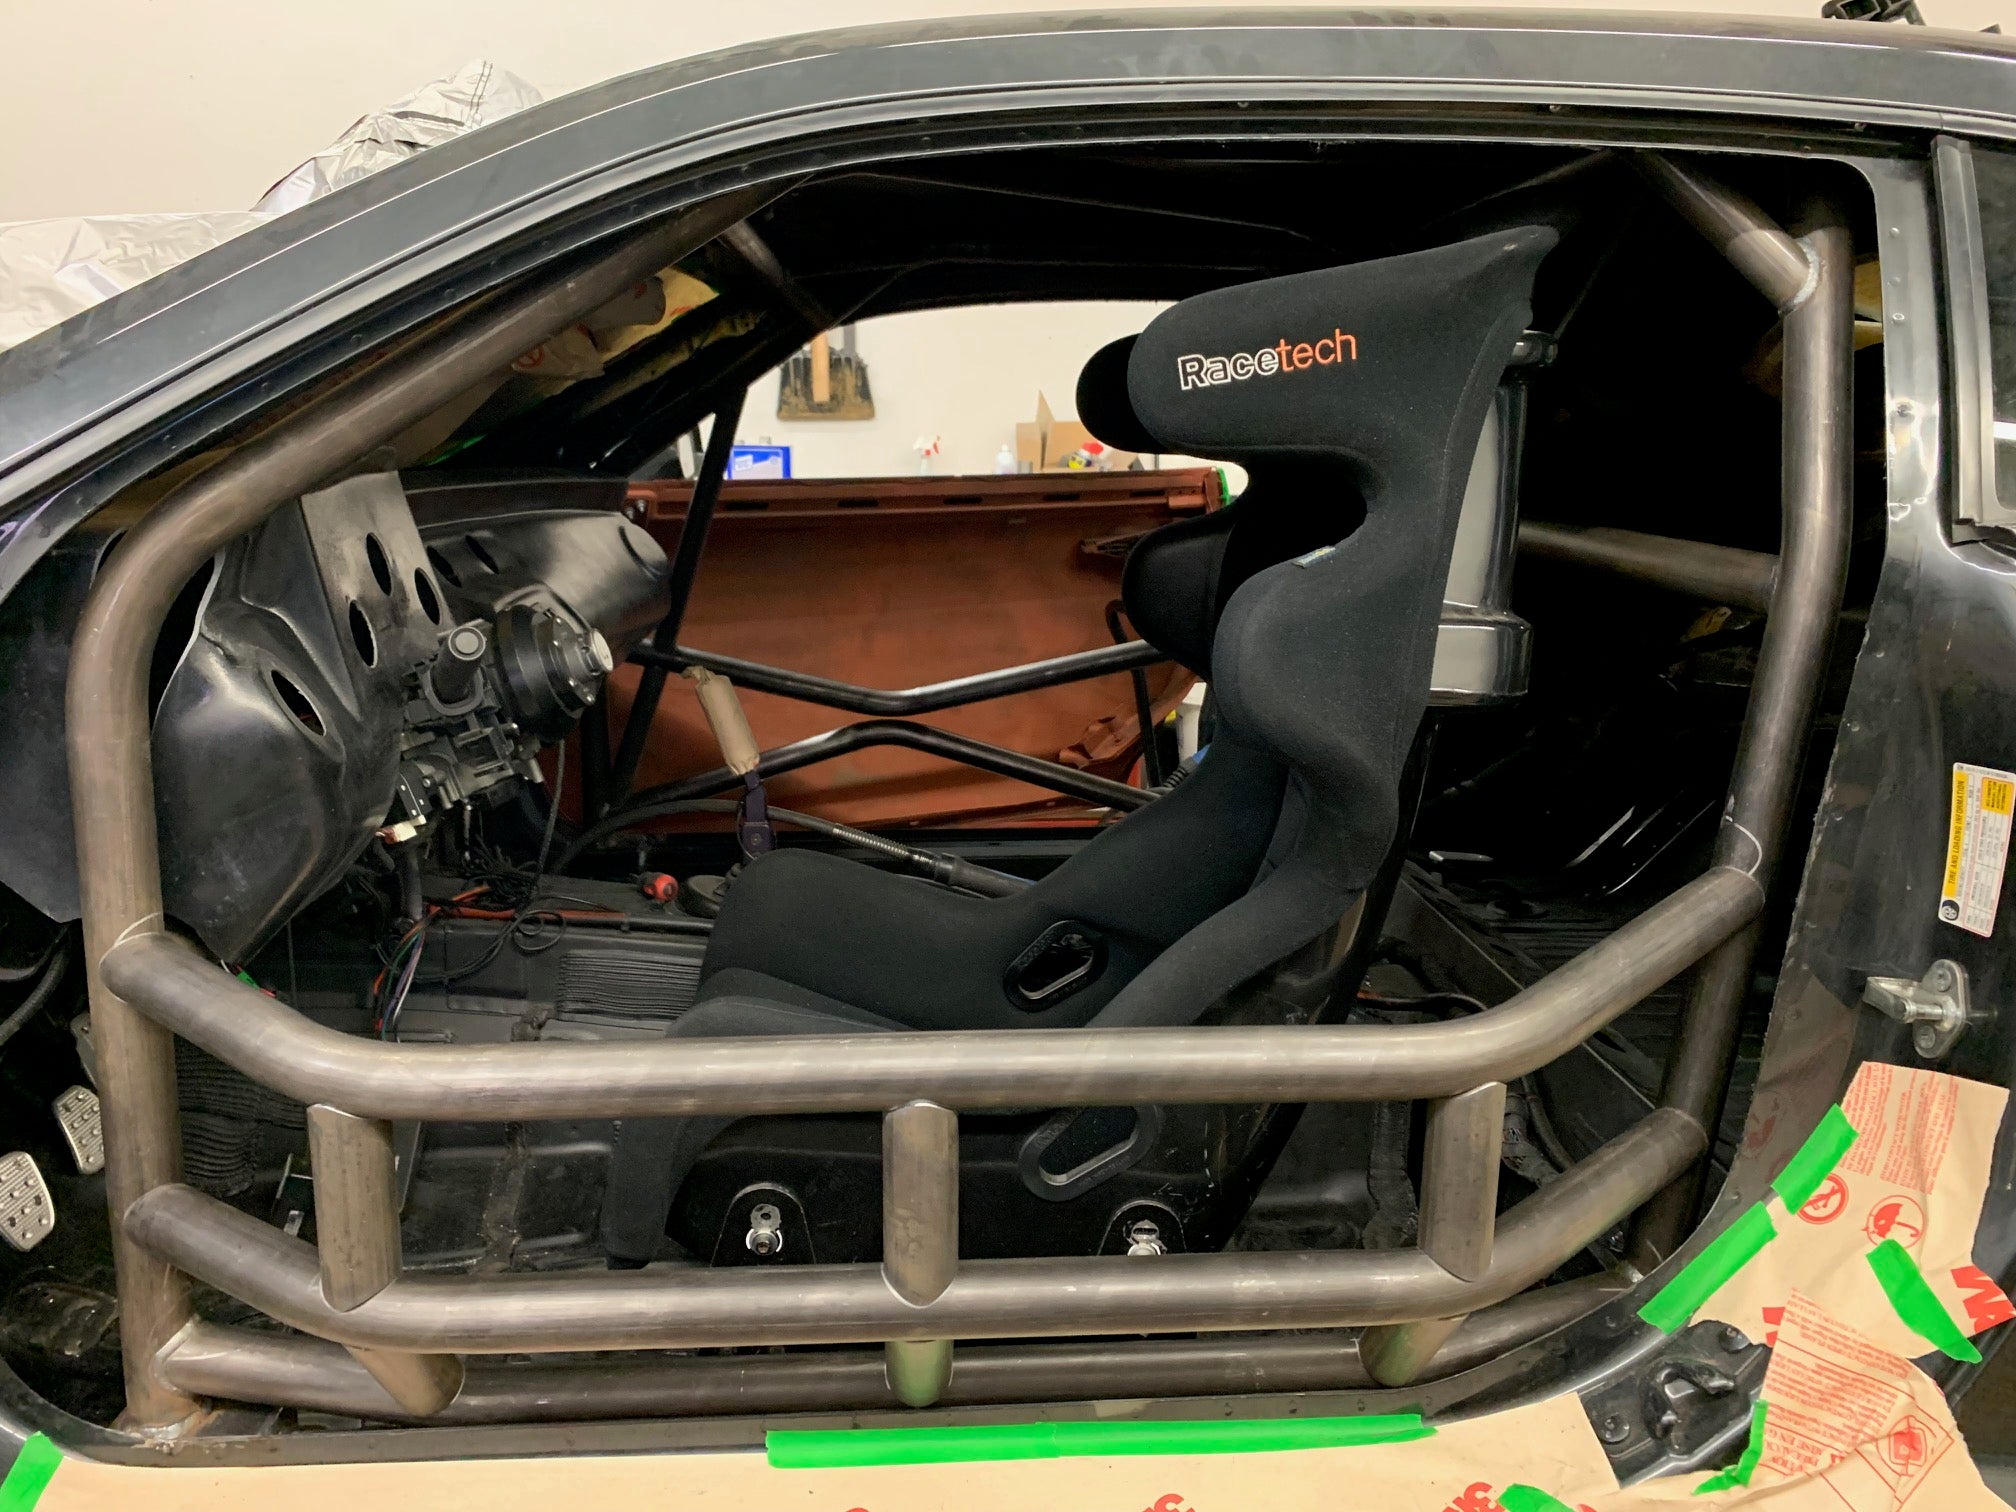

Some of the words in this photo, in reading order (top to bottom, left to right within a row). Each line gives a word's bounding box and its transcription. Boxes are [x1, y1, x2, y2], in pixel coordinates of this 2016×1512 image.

[1177, 329, 1358, 391] Racetech
[1955, 780, 1964, 824] INFORMATION
[1952, 825, 1961, 853] LOADING
[1950, 854, 1958, 868] AND
[1948, 870, 1956, 885] TIRE
